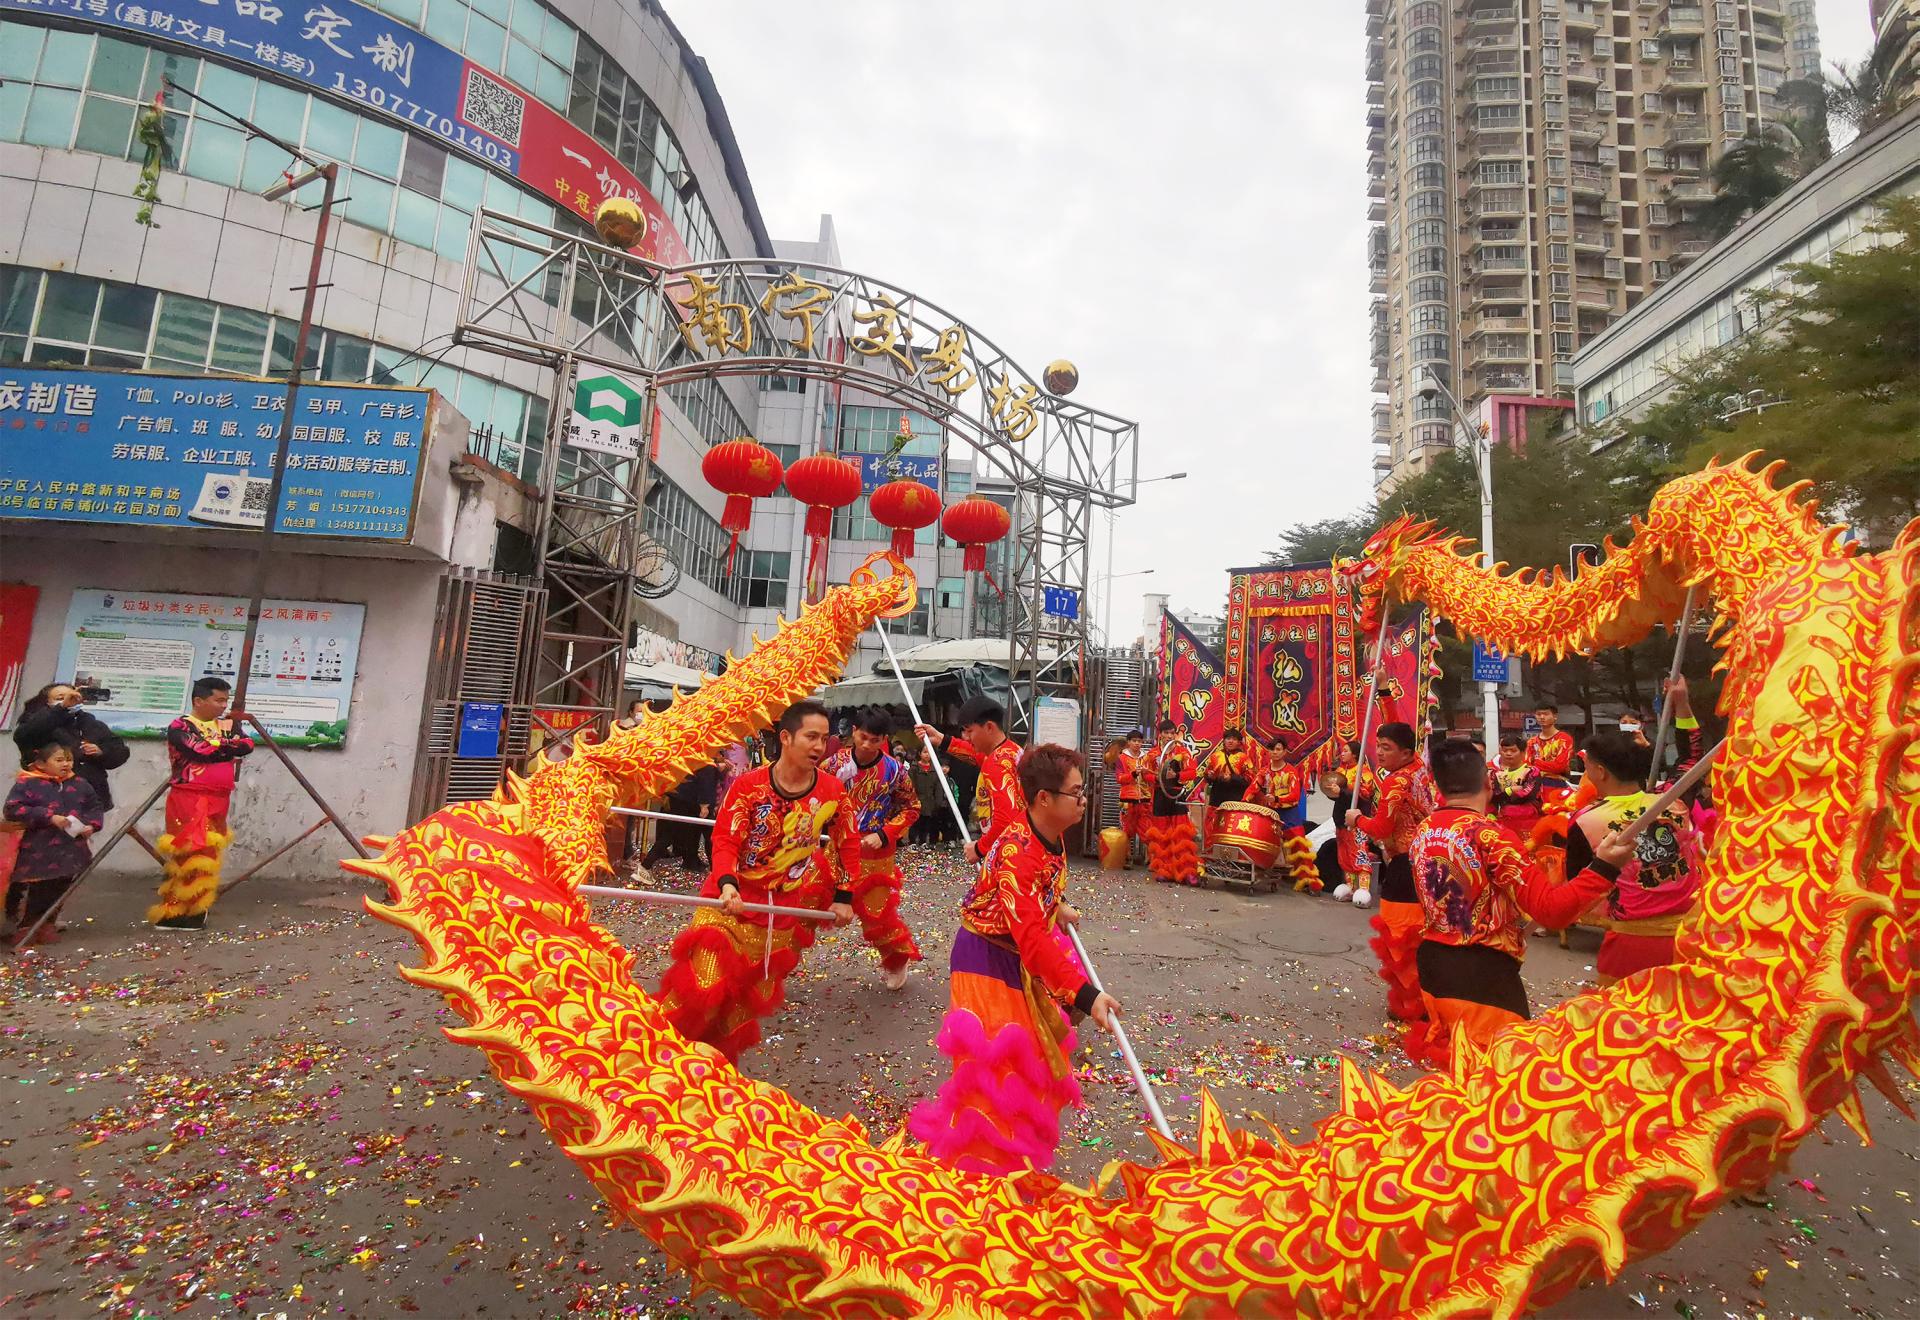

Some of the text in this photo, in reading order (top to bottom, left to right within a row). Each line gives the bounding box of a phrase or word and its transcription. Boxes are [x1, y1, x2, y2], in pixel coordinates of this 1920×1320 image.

[332, 72, 511, 166] 13077701403
[570, 426, 639, 447] 威宁市场
[1055, 597, 1068, 610] 17
